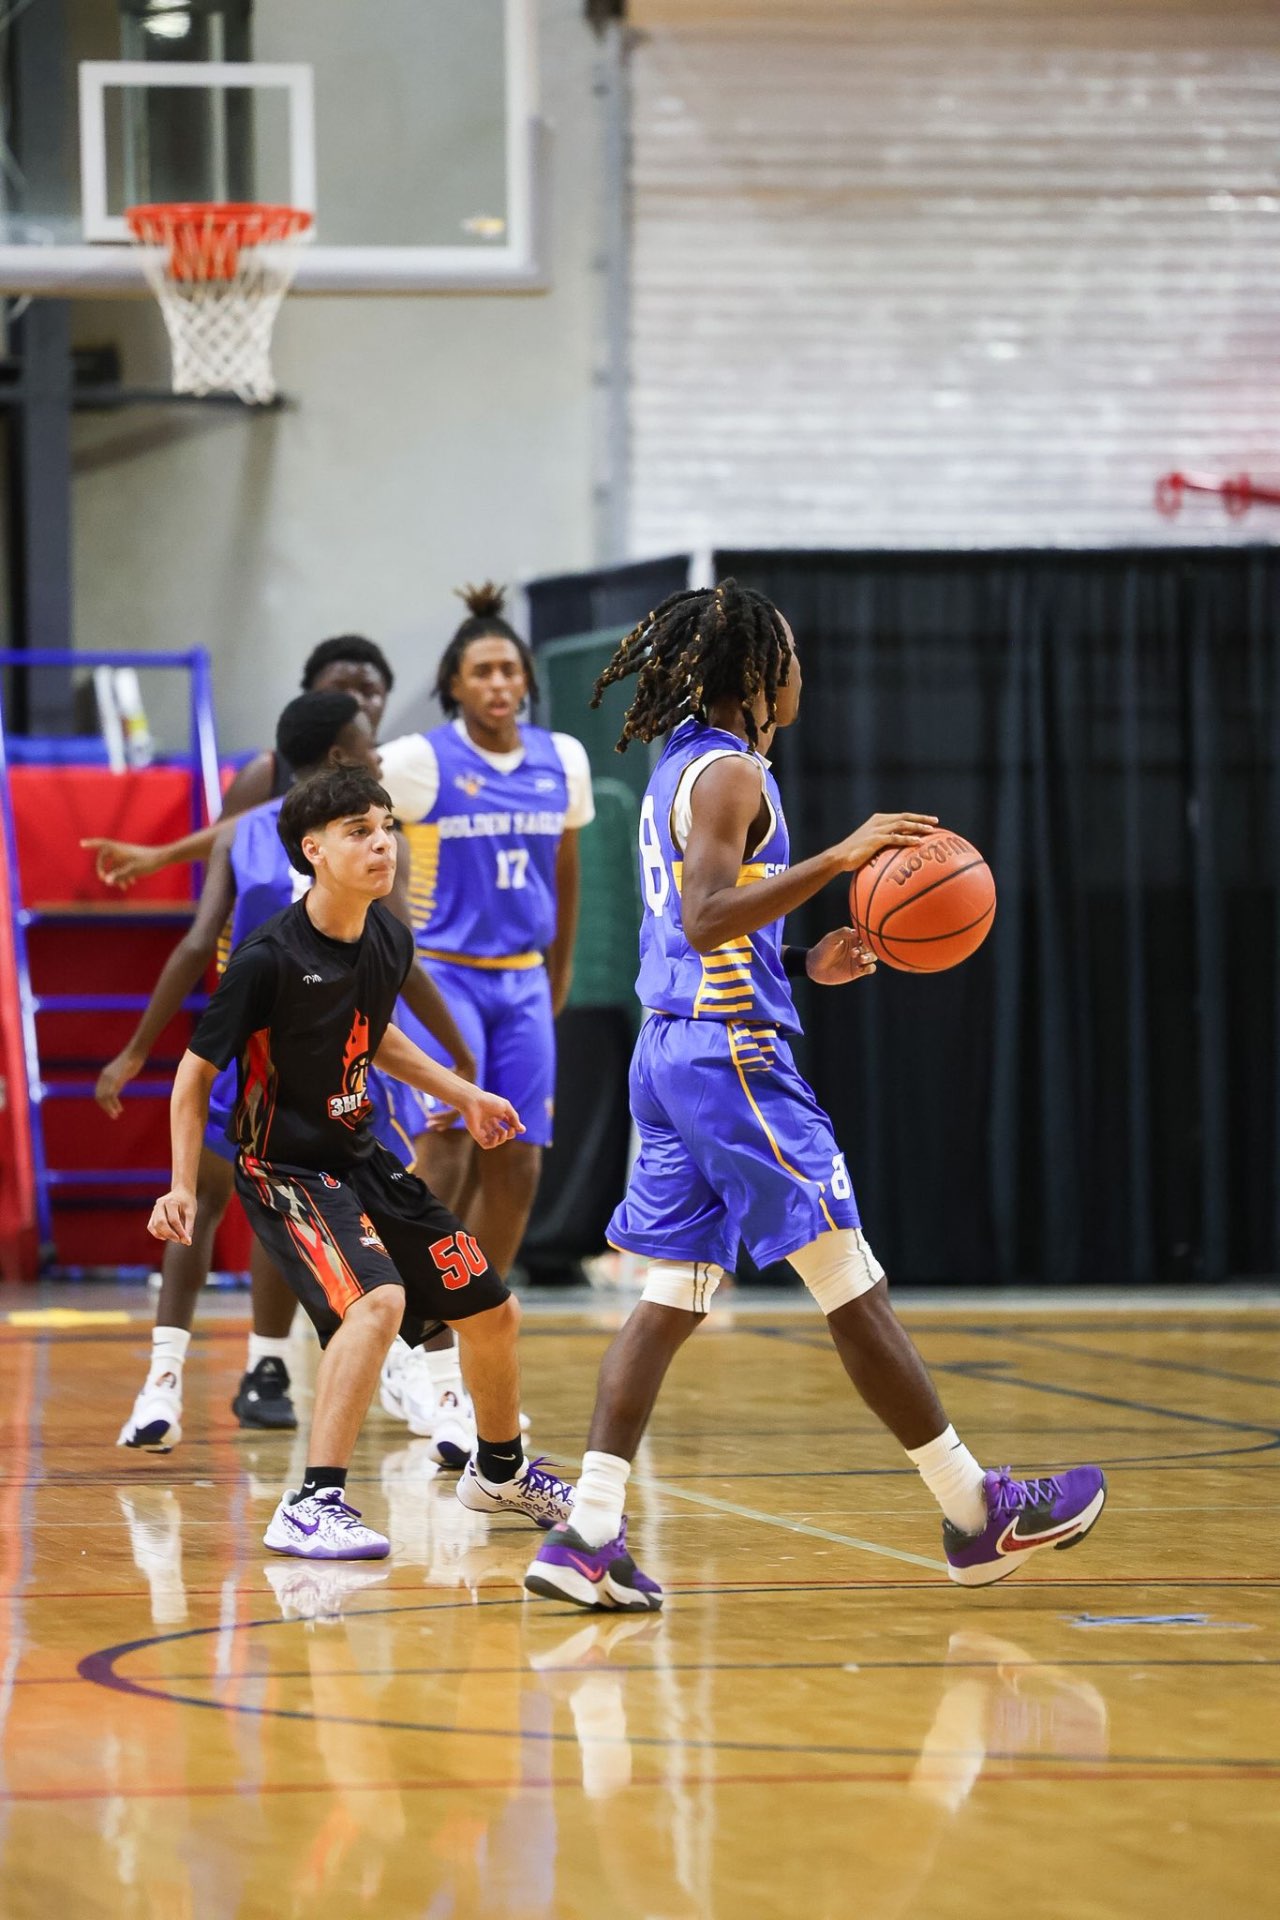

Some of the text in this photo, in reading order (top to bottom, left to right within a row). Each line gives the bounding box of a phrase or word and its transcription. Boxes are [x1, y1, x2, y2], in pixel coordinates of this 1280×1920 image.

[496, 849, 529, 889] 17
[639, 795, 670, 917] 8
[893, 837, 975, 886] Wilson
[428, 1230, 488, 1290] 50
